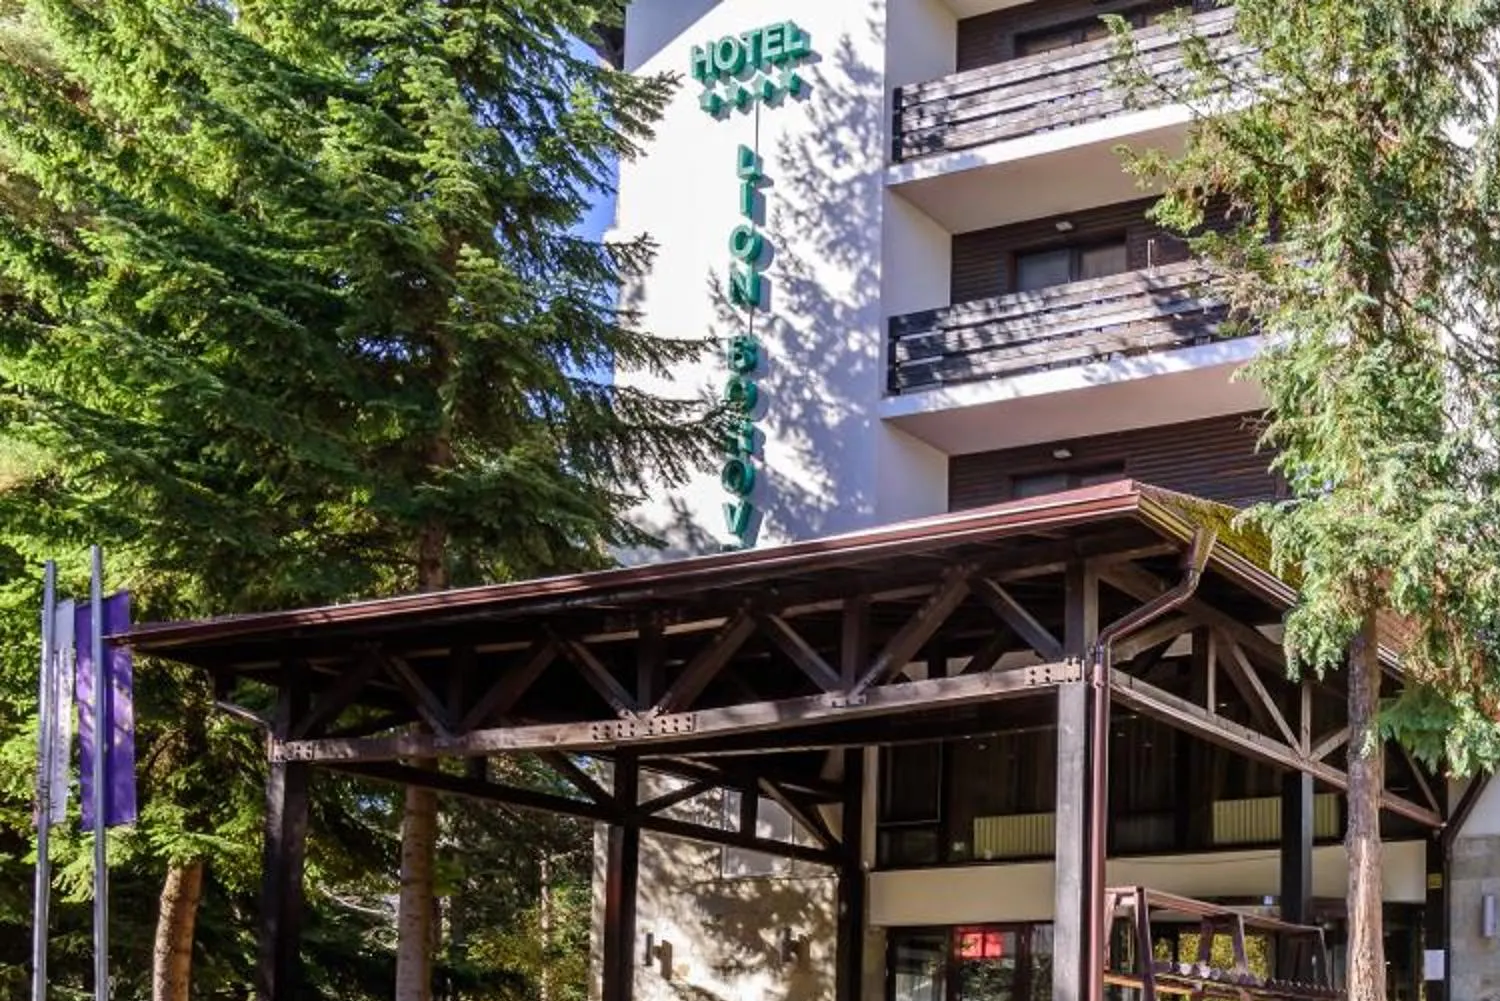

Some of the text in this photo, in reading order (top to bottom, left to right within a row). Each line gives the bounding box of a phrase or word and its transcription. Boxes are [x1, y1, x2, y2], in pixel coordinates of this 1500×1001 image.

[690, 19, 810, 81] HOTEL
[721, 143, 763, 550] LION BOROV
